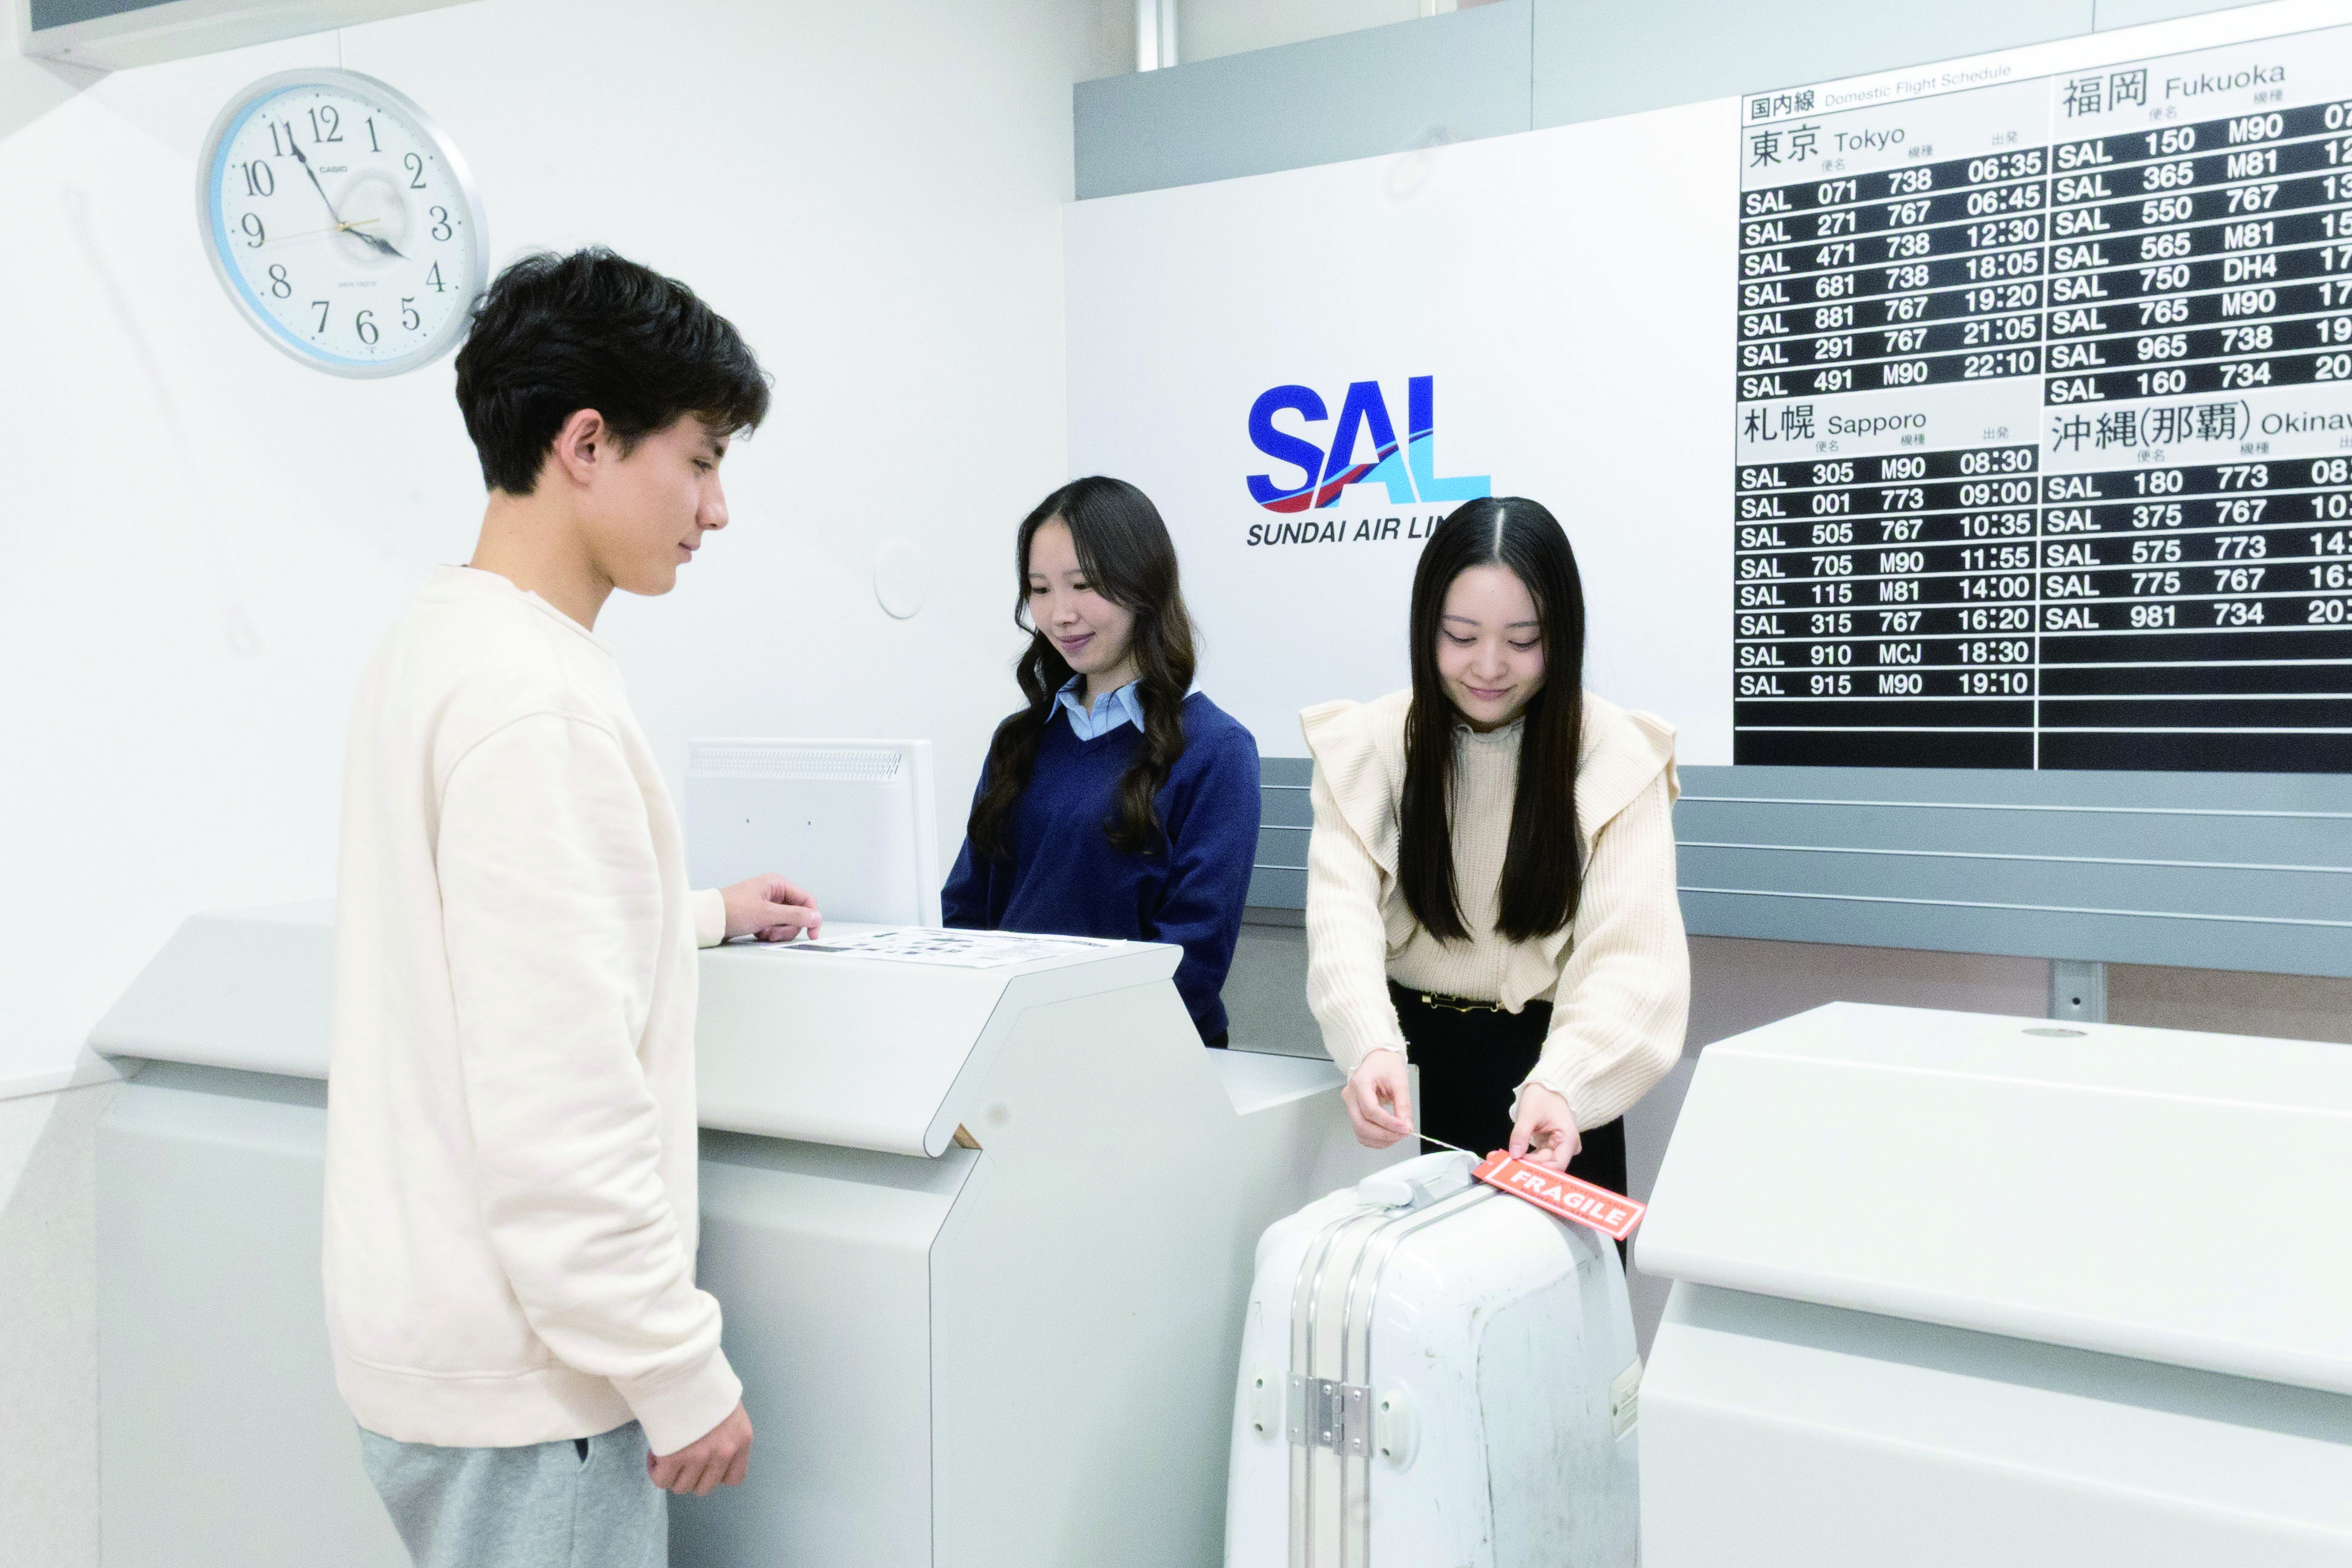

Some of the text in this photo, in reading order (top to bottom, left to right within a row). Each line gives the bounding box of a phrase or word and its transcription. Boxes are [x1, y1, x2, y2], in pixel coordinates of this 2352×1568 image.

[1751, 65, 2011, 120] 国内線 Domestic Flight Schedule
[2063, 65, 2285, 118] 福岡 Fukuoka
[2149, 89, 2283, 121] 便名 機種
[268, 120, 299, 158] 11
[308, 105, 344, 143] 12
[364, 116, 382, 153] 1
[2057, 140, 2113, 169] SAL
[2145, 126, 2196, 156] 150
[2228, 113, 2284, 144] M90
[1750, 124, 1905, 167] 東京 Tokyo
[1821, 131, 2019, 172] 便名 機種 出発
[241, 159, 275, 197] 10
[404, 152, 426, 189] 2
[1745, 151, 2042, 215] SAL 071 738 06:35
[2056, 174, 2112, 203] SAL
[2143, 161, 2194, 191] 365
[2227, 148, 2277, 179] M81
[430, 205, 452, 241] 3
[1745, 184, 2040, 246] SAL 271 767 06:45
[2055, 207, 2111, 236] SAL
[2141, 195, 2193, 224] 550
[2226, 183, 2279, 214] 767
[241, 212, 265, 249] 9
[1745, 217, 2040, 276] SAL 471 738 12:30
[2054, 243, 2109, 270] SAL
[2140, 232, 2191, 260] 565
[2224, 221, 2274, 250] M81
[269, 263, 292, 299] 8
[426, 260, 447, 293] 4
[1744, 250, 2039, 307] SAL 681 738 18:05
[2053, 275, 2108, 301] SAL
[2140, 264, 2190, 292] 750
[2224, 253, 2277, 283] DH4
[311, 300, 330, 334] 7
[355, 309, 379, 345] 6
[401, 296, 421, 331] 5
[1743, 283, 2037, 337] SAL 881 767 19:20
[2053, 308, 2106, 334] SAL
[2139, 298, 2189, 325] 765
[2222, 289, 2276, 316] M90
[1743, 316, 2036, 367] SAL 291 767 21:05
[2051, 342, 2106, 369] SAL
[2137, 333, 2187, 361] 965
[2221, 325, 2273, 353] 738
[1742, 350, 2035, 399] SAL 491 M90 22:10
[2050, 377, 2105, 403] SAL
[2137, 369, 2186, 395] 160
[2220, 361, 2272, 388] 734
[1743, 404, 1927, 443] 札幌 Sapporo
[1815, 426, 2009, 452] 便名 機種 出発
[2261, 411, 2352, 435] Okina
[1246, 375, 1491, 513] SAL
[2137, 449, 2166, 463] 便名
[2239, 442, 2270, 456] 機種
[1741, 448, 2032, 489] SAL 305 M90 08:30
[2048, 475, 2102, 500] SAL
[2134, 469, 2183, 494] 180
[2216, 464, 2269, 489] 773
[1741, 480, 2032, 518] SAL 001 773 09:00
[2047, 508, 2102, 533] SAL
[2132, 504, 2182, 528] 375
[2216, 498, 2267, 524] 767
[1247, 520, 1347, 546] SUNDAI
[1353, 518, 1401, 541] AIR
[1741, 512, 2031, 548] SAL 505 767 10:35
[1740, 546, 2030, 579] SAL 705 M90 11:55
[2047, 543, 2100, 567] SAL
[2132, 539, 2181, 563] 575
[2215, 535, 2267, 560] 773
[1740, 576, 2030, 606] SAL 115 M81 14:00
[2046, 574, 2100, 598] SAL
[2131, 571, 2181, 594] 775
[2214, 567, 2265, 592] 767
[1740, 607, 2029, 635] SAL 315 767 16:20
[2045, 607, 2099, 630] SAL
[2131, 605, 2175, 628] 981
[2213, 602, 2264, 626] 734
[1740, 641, 2029, 666] SAL 910 MCJ 18:30
[1740, 672, 2028, 695] SAL 915 M90 19:10
[1510, 1170, 1627, 1226] FRAGILE
